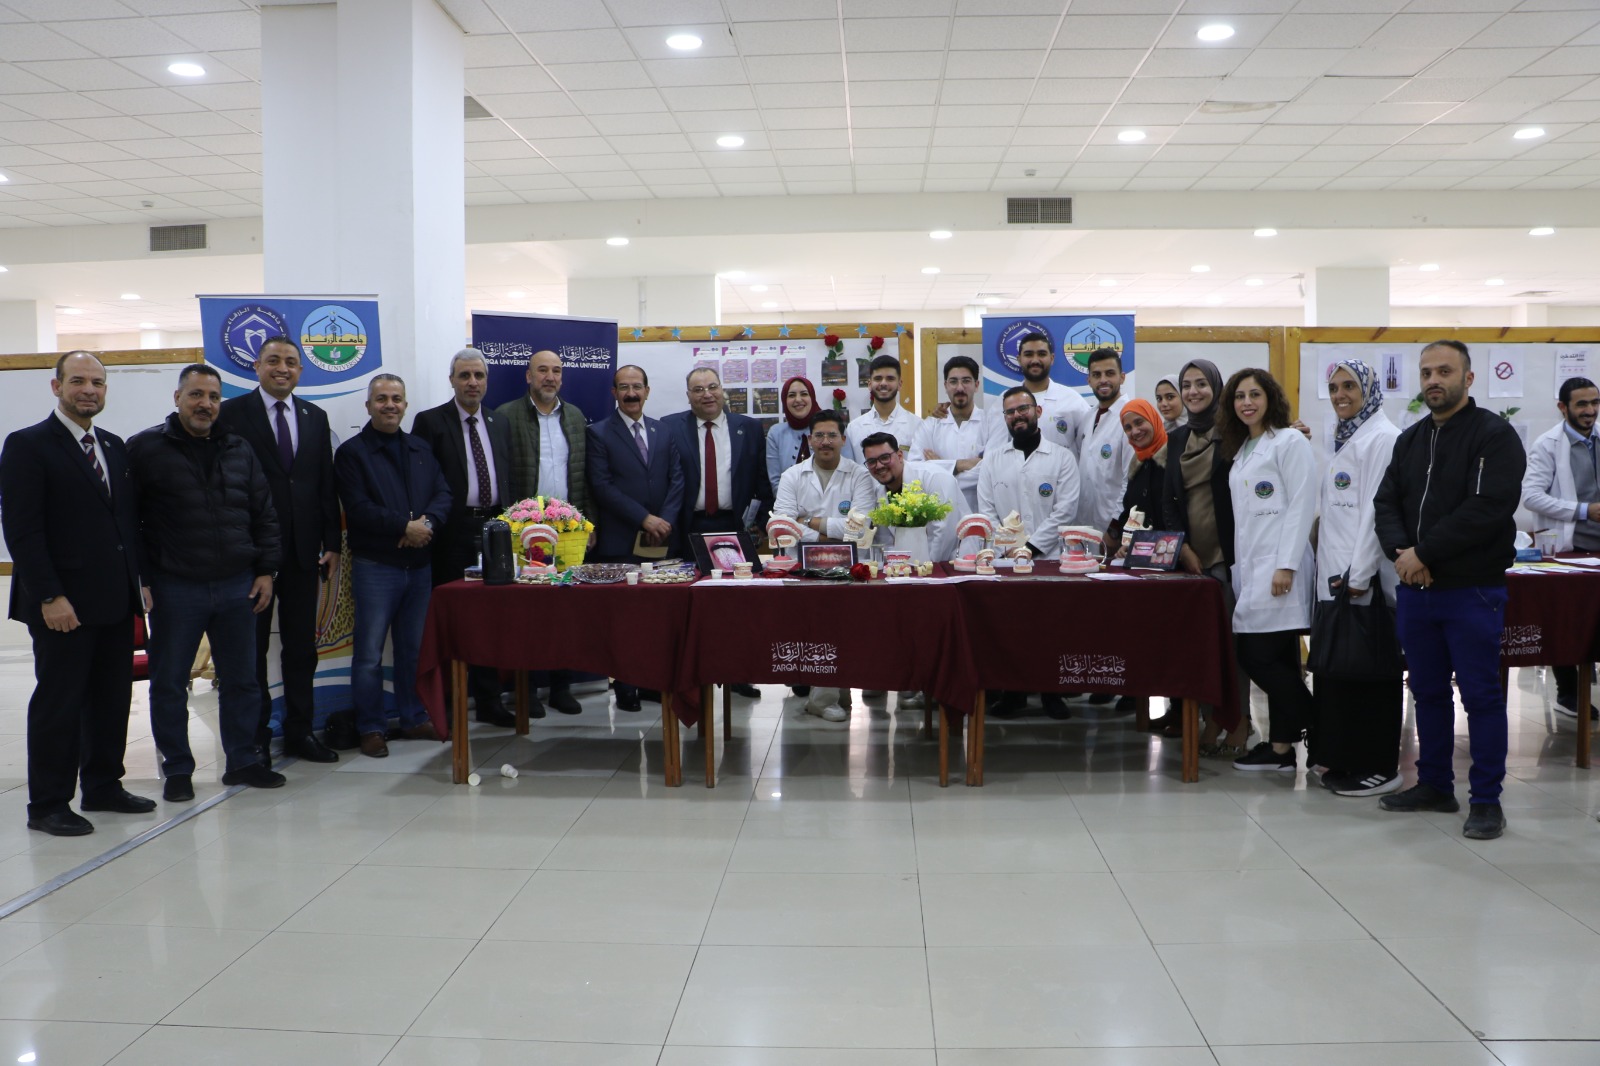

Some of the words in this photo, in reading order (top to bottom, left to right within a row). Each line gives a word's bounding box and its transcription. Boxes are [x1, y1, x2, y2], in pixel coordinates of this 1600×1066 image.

[227, 306, 250, 325] الزرقاء
[257, 306, 280, 325] جامعة
[305, 332, 338, 344] الزرقاء
[503, 342, 533, 360] جامعة
[559, 345, 585, 361] الزرقاء
[581, 347, 611, 363] جامعة
[306, 351, 327, 369] ZARQA
[328, 350, 365, 371] UNIVERSITY
[771, 641, 805, 662] الزرقاء
[803, 642, 838, 665] جامعة
[1508, 646, 1542, 655] UNIVERSITY
[772, 663, 798, 672] ZARQA
[800, 664, 838, 673] UNIVERSITY
[1059, 654, 1093, 674] الزرقاء
[1090, 655, 1126, 676] جامعة
[1059, 676, 1085, 685] ZARQA
[1087, 676, 1126, 685] UNIVERSITY
